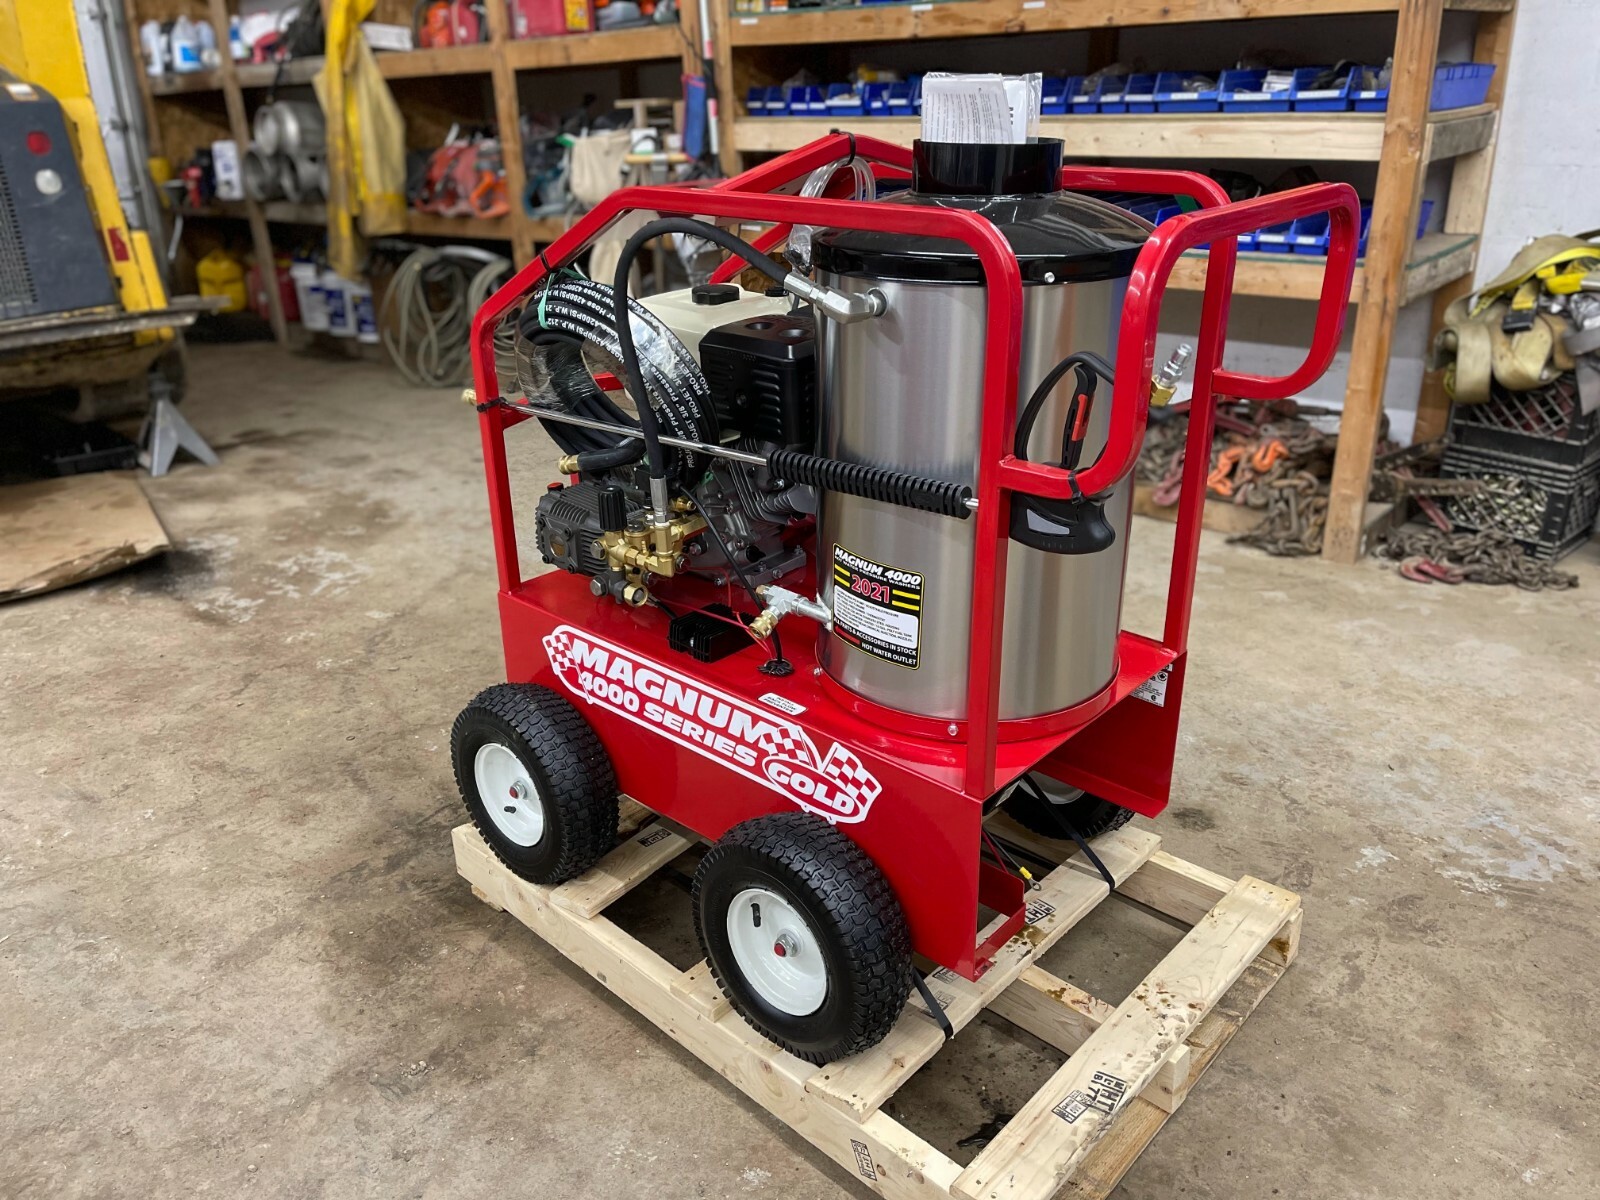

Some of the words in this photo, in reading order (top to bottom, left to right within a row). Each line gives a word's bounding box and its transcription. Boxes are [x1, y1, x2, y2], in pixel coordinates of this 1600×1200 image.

[560, 291, 586, 305] 4200PSI
[584, 288, 602, 300] Hose
[570, 309, 601, 327] 4200PSI
[587, 301, 606, 316] Hose
[576, 327, 605, 347] 4200PSI
[650, 366, 680, 402] Pressure
[675, 404, 689, 418] 3/8"
[679, 361, 703, 396] PROJET
[652, 391, 679, 426] Pressure
[679, 387, 702, 419] PROJET
[834, 547, 883, 575] MAGNUM
[884, 570, 921, 585] 4000
[859, 569, 888, 582] PRESSURE
[889, 579, 920, 590] WASHERS
[851, 574, 890, 603] 2021
[856, 630, 889, 649] ACCESSORIES
[897, 646, 917, 657] STOCK
[861, 642, 873, 651] HOT
[873, 647, 892, 659] WATER
[892, 653, 917, 665] OUTLET
[571, 638, 780, 748] MAGNUM
[577, 671, 640, 713] 4000
[643, 702, 758, 767] SERIES
[767, 762, 854, 815] GOLD
[1097, 1088, 1120, 1112] HT
